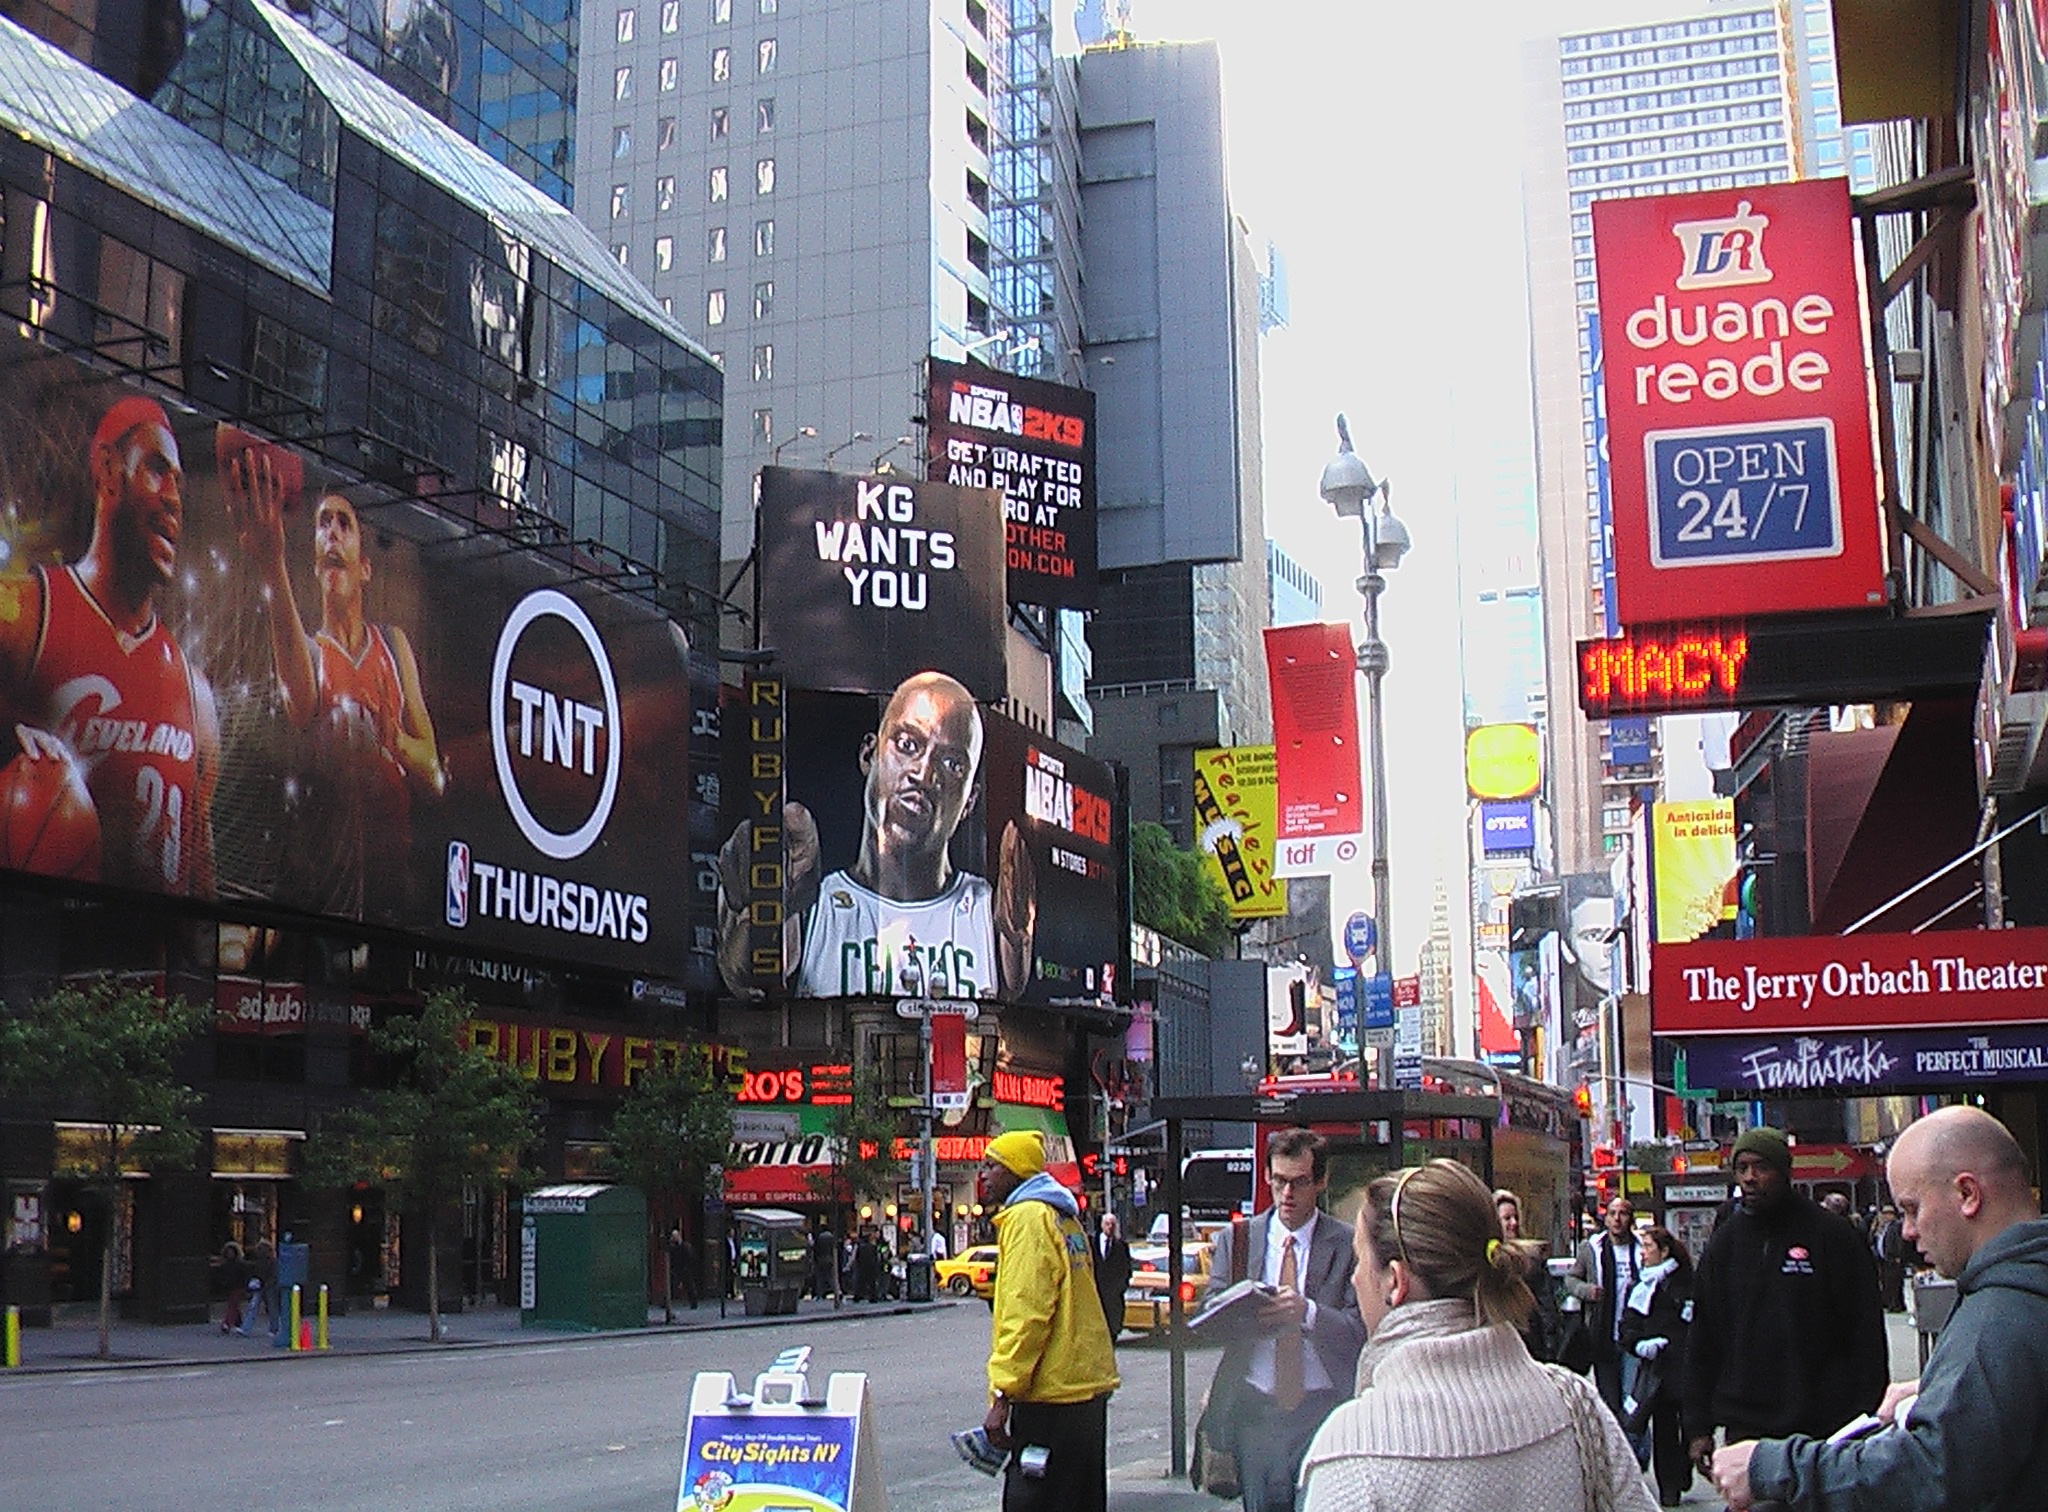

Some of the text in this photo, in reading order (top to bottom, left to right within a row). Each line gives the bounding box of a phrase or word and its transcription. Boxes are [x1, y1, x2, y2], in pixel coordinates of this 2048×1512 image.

[1625, 293, 1836, 349] duane
[1634, 344, 1831, 405] reade
[949, 392, 1085, 448] NBA 2K9
[947, 439, 1082, 485] GET DRAFTED
[948, 464, 1082, 509] AND PLAY FOR
[1672, 440, 1807, 487] OPEN
[857, 480, 914, 524] KG
[1035, 504, 1059, 528] AT
[1676, 483, 1810, 542] 24/7
[815, 521, 956, 570] WANTS
[843, 567, 928, 611] YOU
[511, 680, 604, 776] TNT
[1025, 765, 1066, 828] NBA
[1286, 843, 1316, 866] tdf
[473, 861, 649, 943] THURSDAYS
[1682, 956, 2047, 1011] The Jerry Orbach Theater
[467, 1018, 612, 1085] RUBY
[1741, 1037, 1899, 1089] Fantasticks
[1916, 1049, 1980, 1073] PERFECT
[812, 1443, 841, 1463] NY
